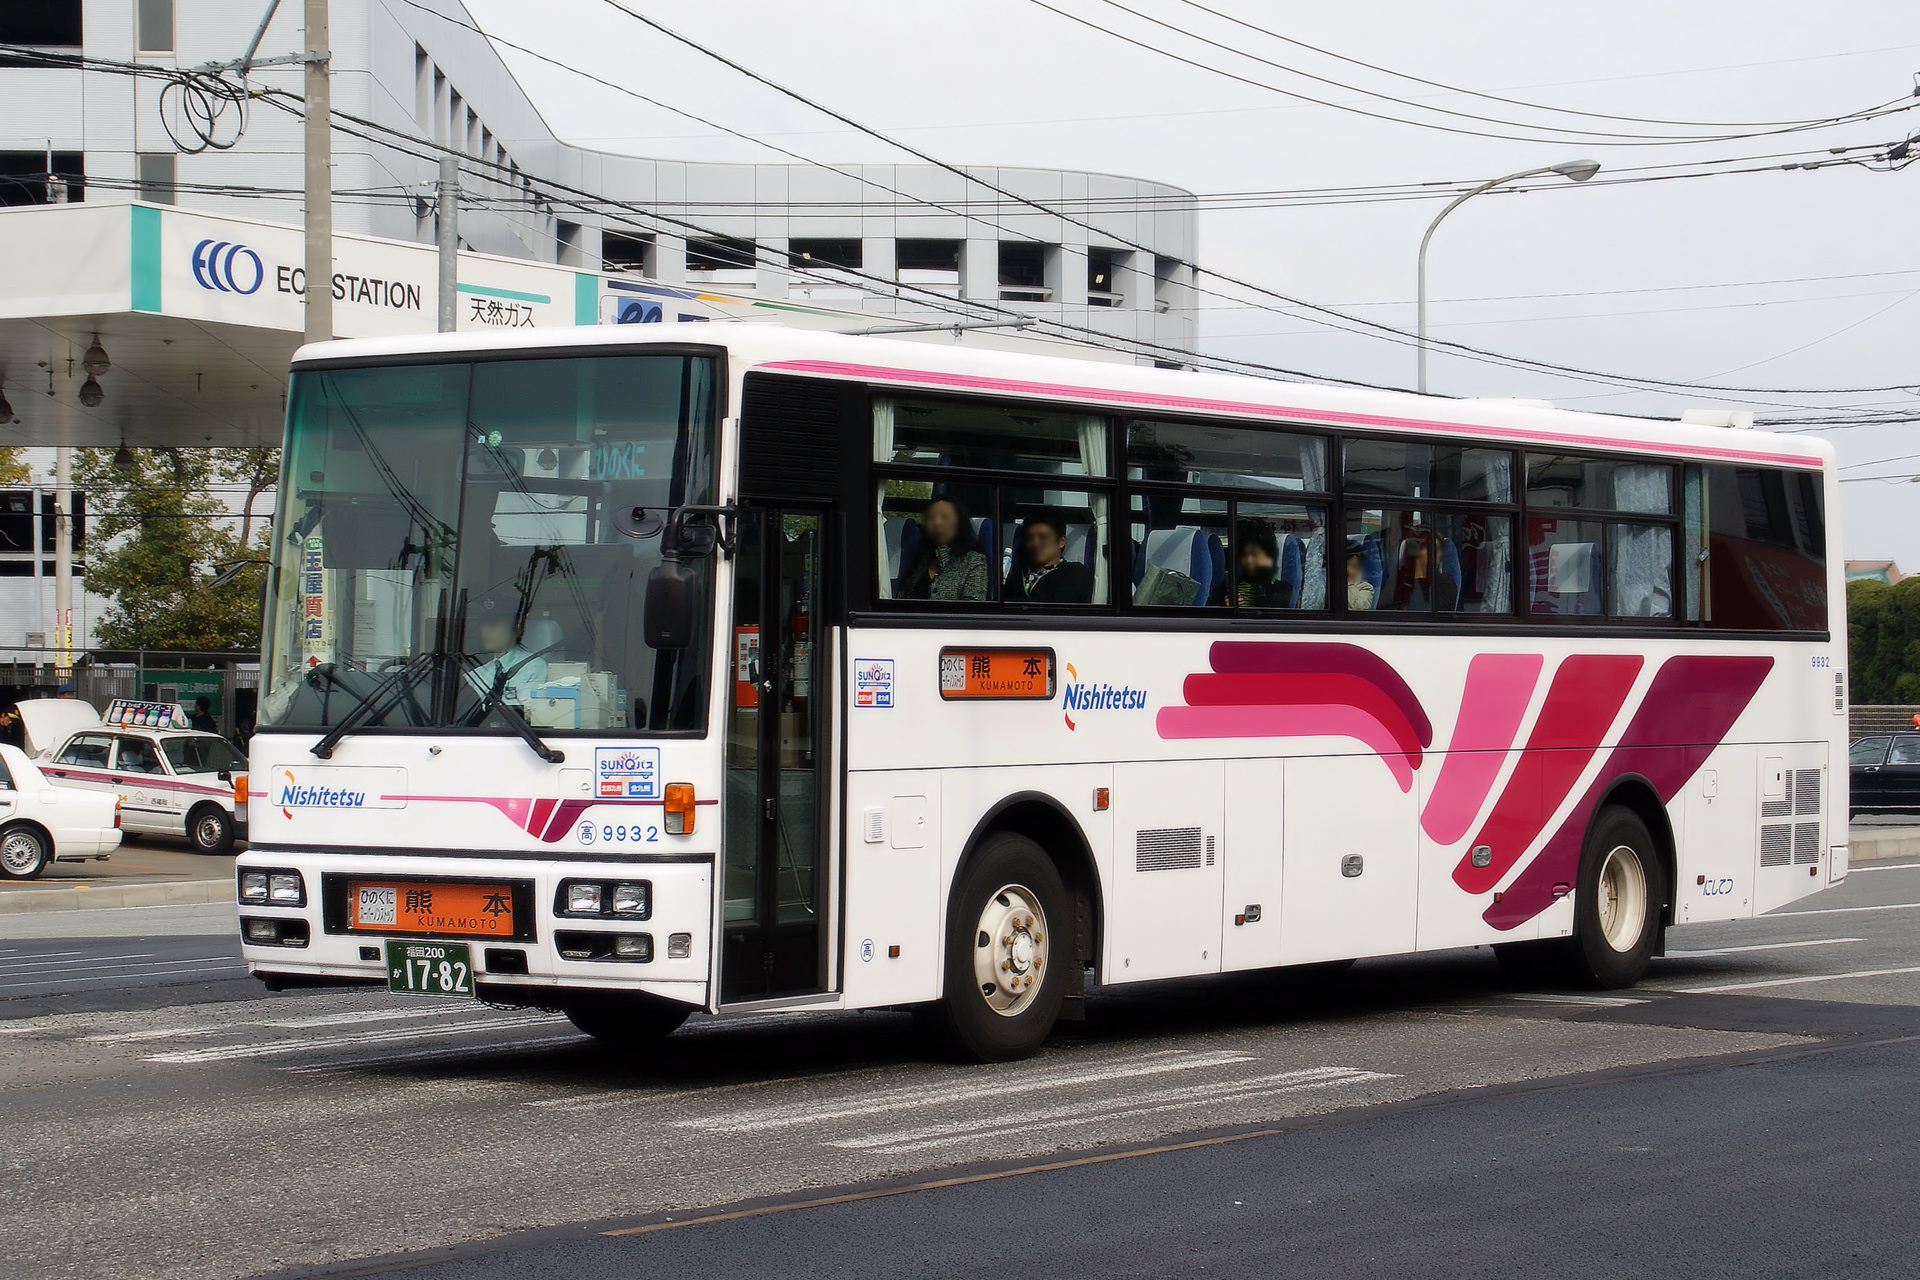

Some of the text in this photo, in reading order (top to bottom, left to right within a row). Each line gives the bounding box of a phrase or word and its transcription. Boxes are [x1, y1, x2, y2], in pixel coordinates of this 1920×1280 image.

[277, 265, 421, 310] EC STATION
[470, 297, 536, 328] 天然ガス
[305, 551, 324, 640] 玉屋質店
[971, 655, 1042, 679] 熊本
[1811, 656, 1830, 668] 9932
[980, 681, 1033, 691] KUMAMOTO
[1062, 683, 1147, 711] Nishitetsu
[600, 758, 654, 771] SUNQバス
[280, 785, 366, 806] Nishitetsu
[580, 825, 658, 842] 高 9932
[1703, 878, 1734, 896] にしてつ
[360, 889, 511, 918] ひのくに 熊本
[417, 916, 497, 930] KUMAMOTO
[405, 959, 469, 992] 17-82
